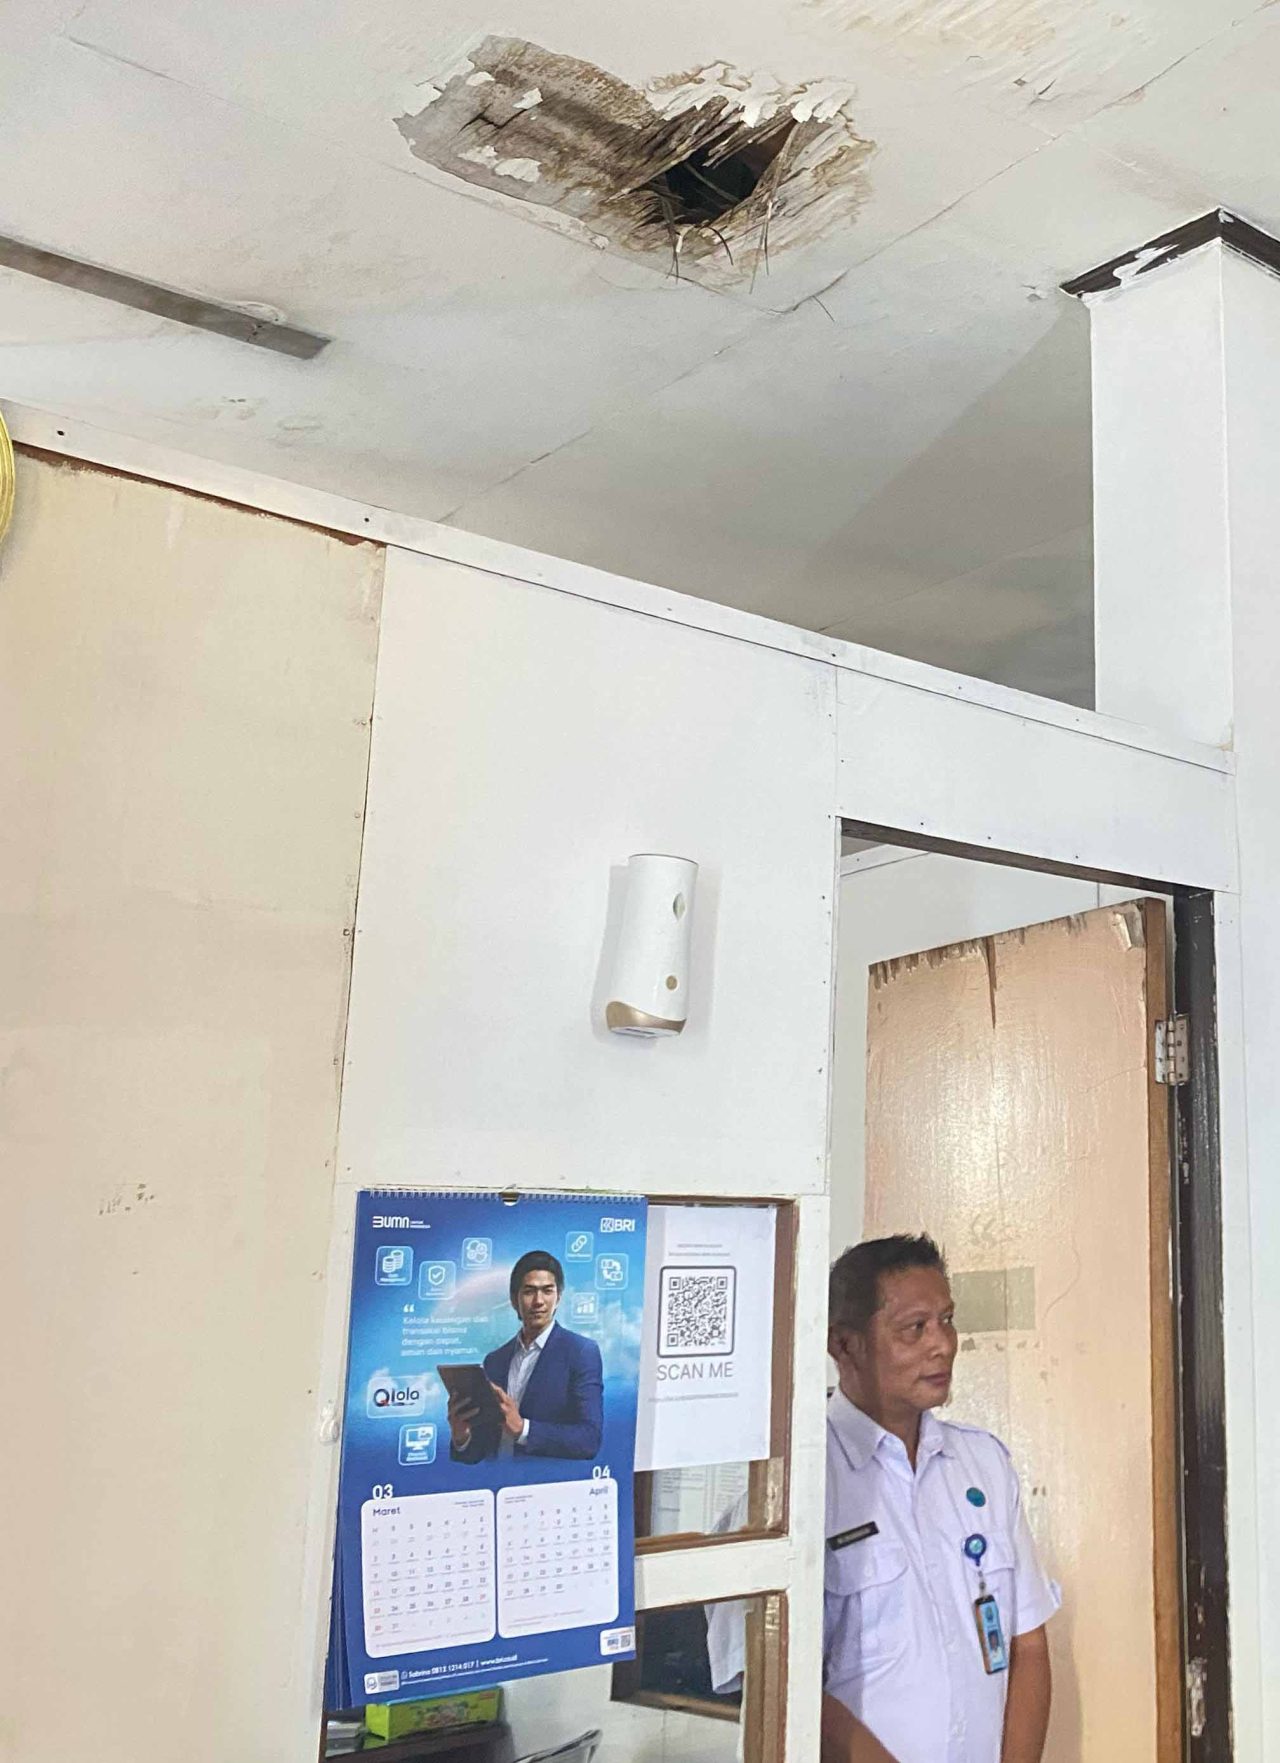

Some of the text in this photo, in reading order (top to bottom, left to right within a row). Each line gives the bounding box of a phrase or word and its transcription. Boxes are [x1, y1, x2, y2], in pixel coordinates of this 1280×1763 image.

[615, 1219, 635, 1231] BRI
[657, 1362, 733, 1382] SCAN ME
[592, 1465, 611, 1479] 04
[372, 1484, 394, 1500] 03
[589, 1486, 609, 1497] April
[372, 1507, 400, 1516] Maret
